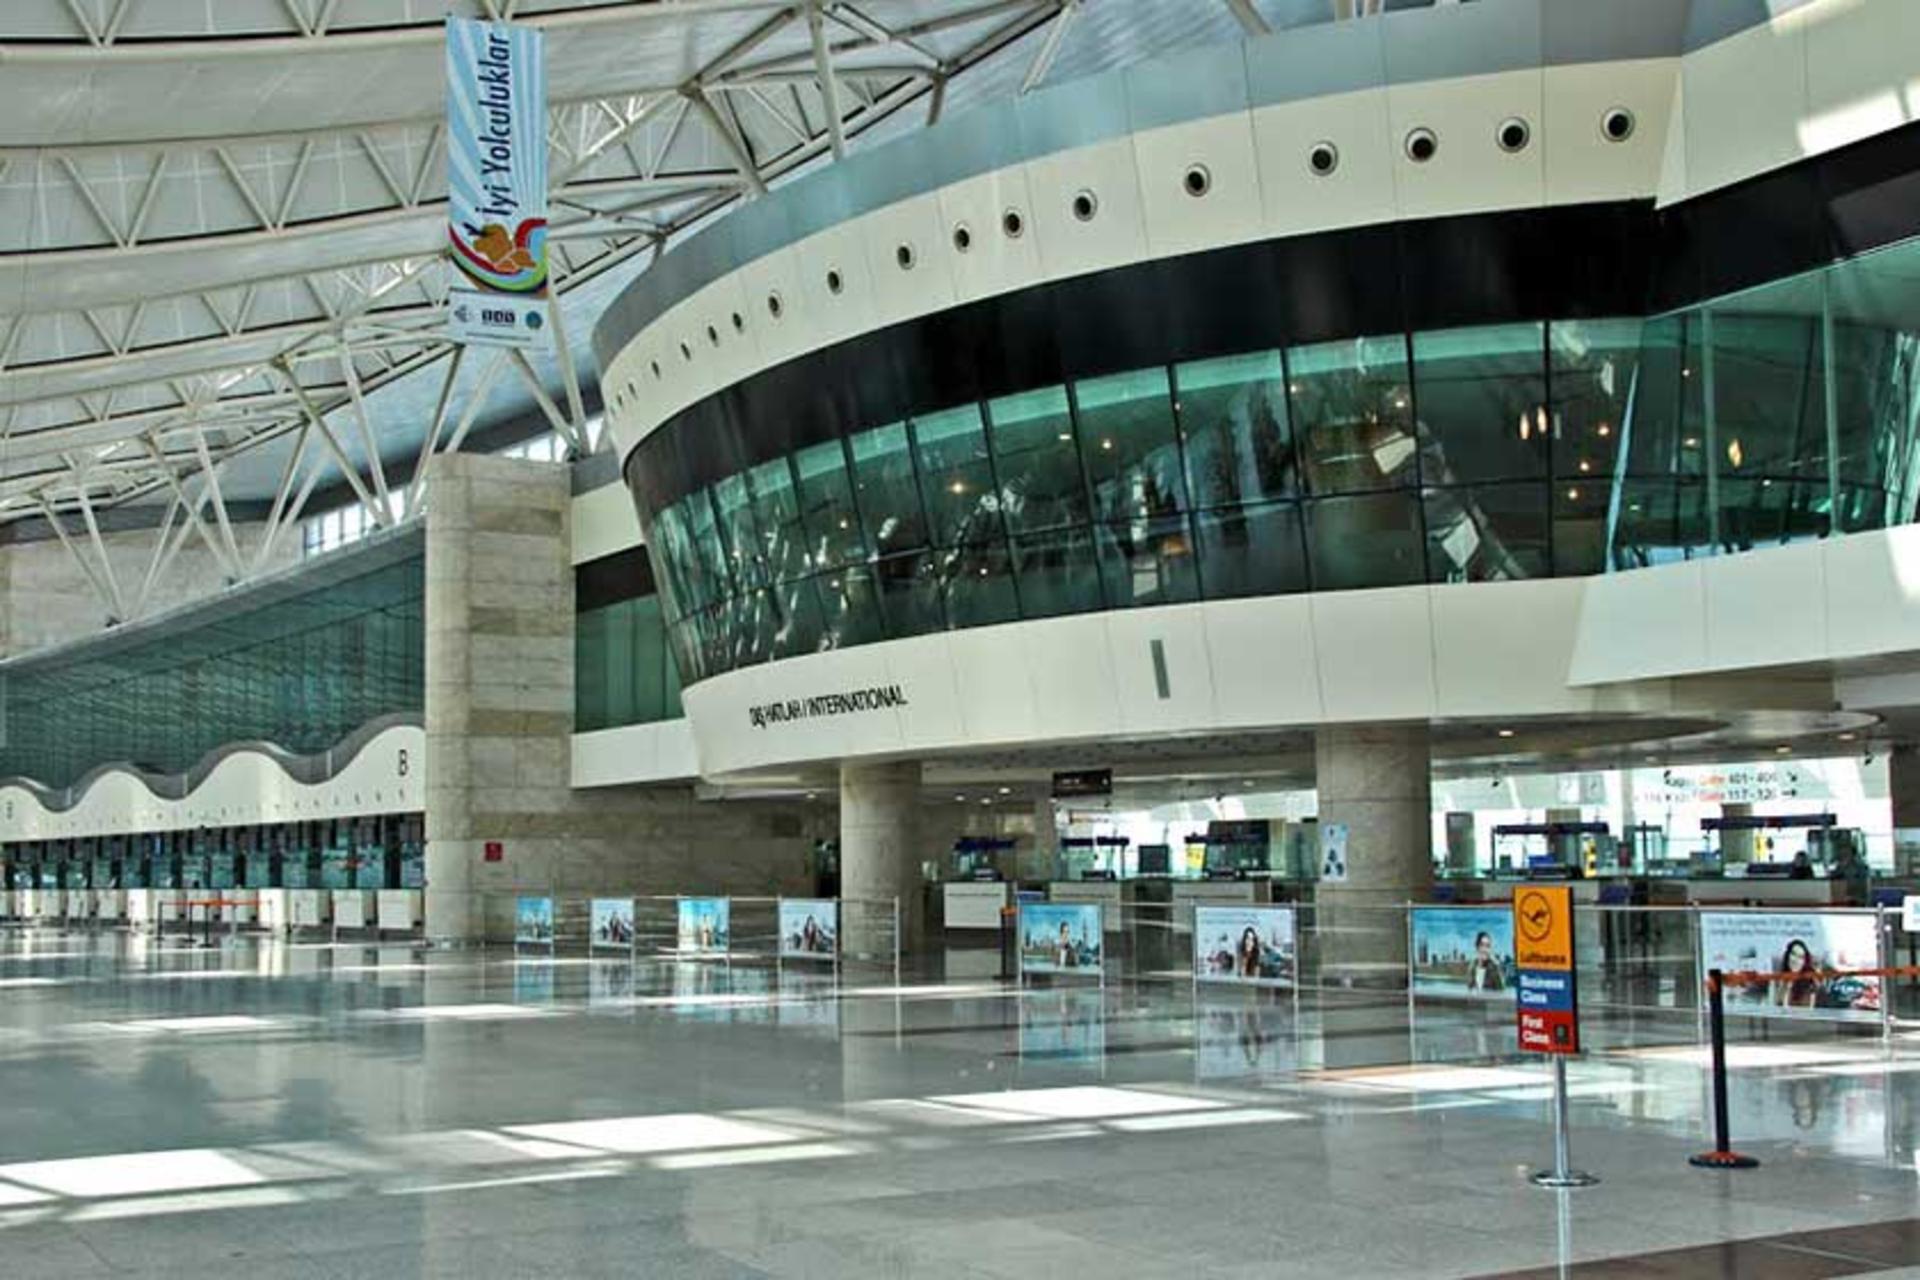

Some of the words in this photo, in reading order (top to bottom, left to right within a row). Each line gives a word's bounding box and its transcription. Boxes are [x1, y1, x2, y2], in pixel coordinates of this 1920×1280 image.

[477, 33, 511, 175] Yolculuklar
[475, 184, 518, 217] İyi
[808, 685, 908, 717] INTERNATIONAL
[398, 749, 408, 776] B
